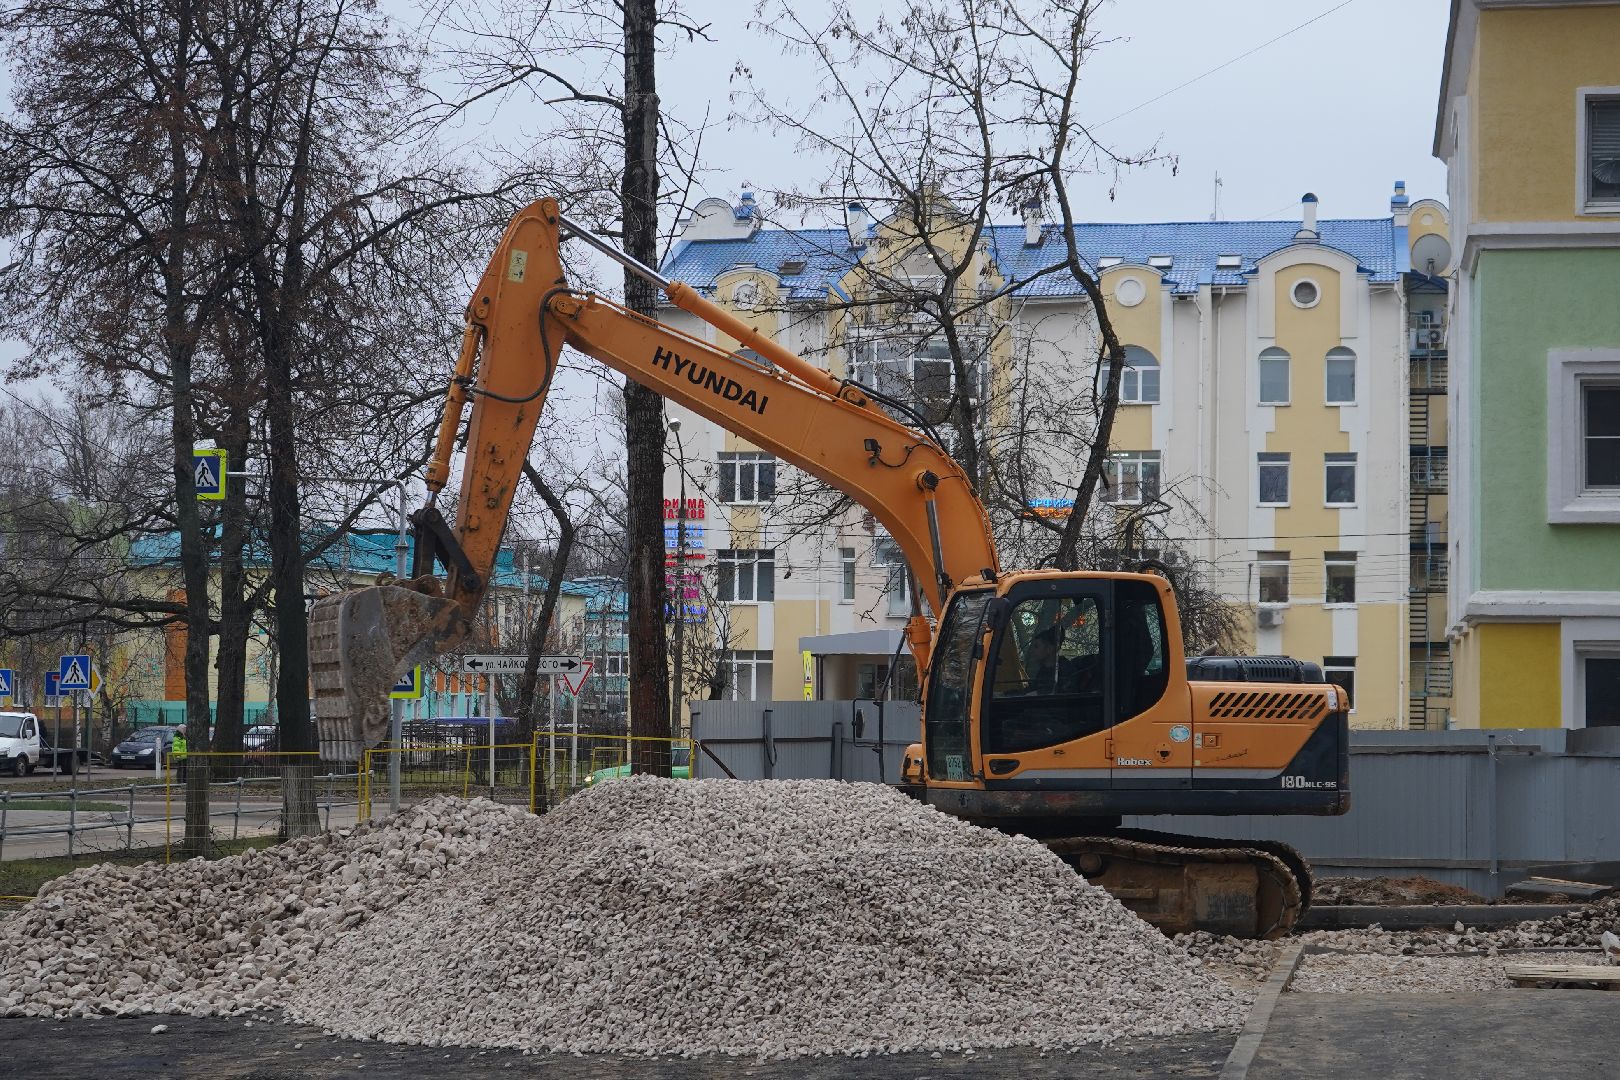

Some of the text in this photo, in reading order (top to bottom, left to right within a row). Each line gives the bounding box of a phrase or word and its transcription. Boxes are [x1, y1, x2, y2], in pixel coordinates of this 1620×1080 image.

[652, 346, 769, 415] HYUNDAI
[663, 498, 705, 508] ФИМА
[485, 658, 559, 670] ул. ЧАЙКООГО
